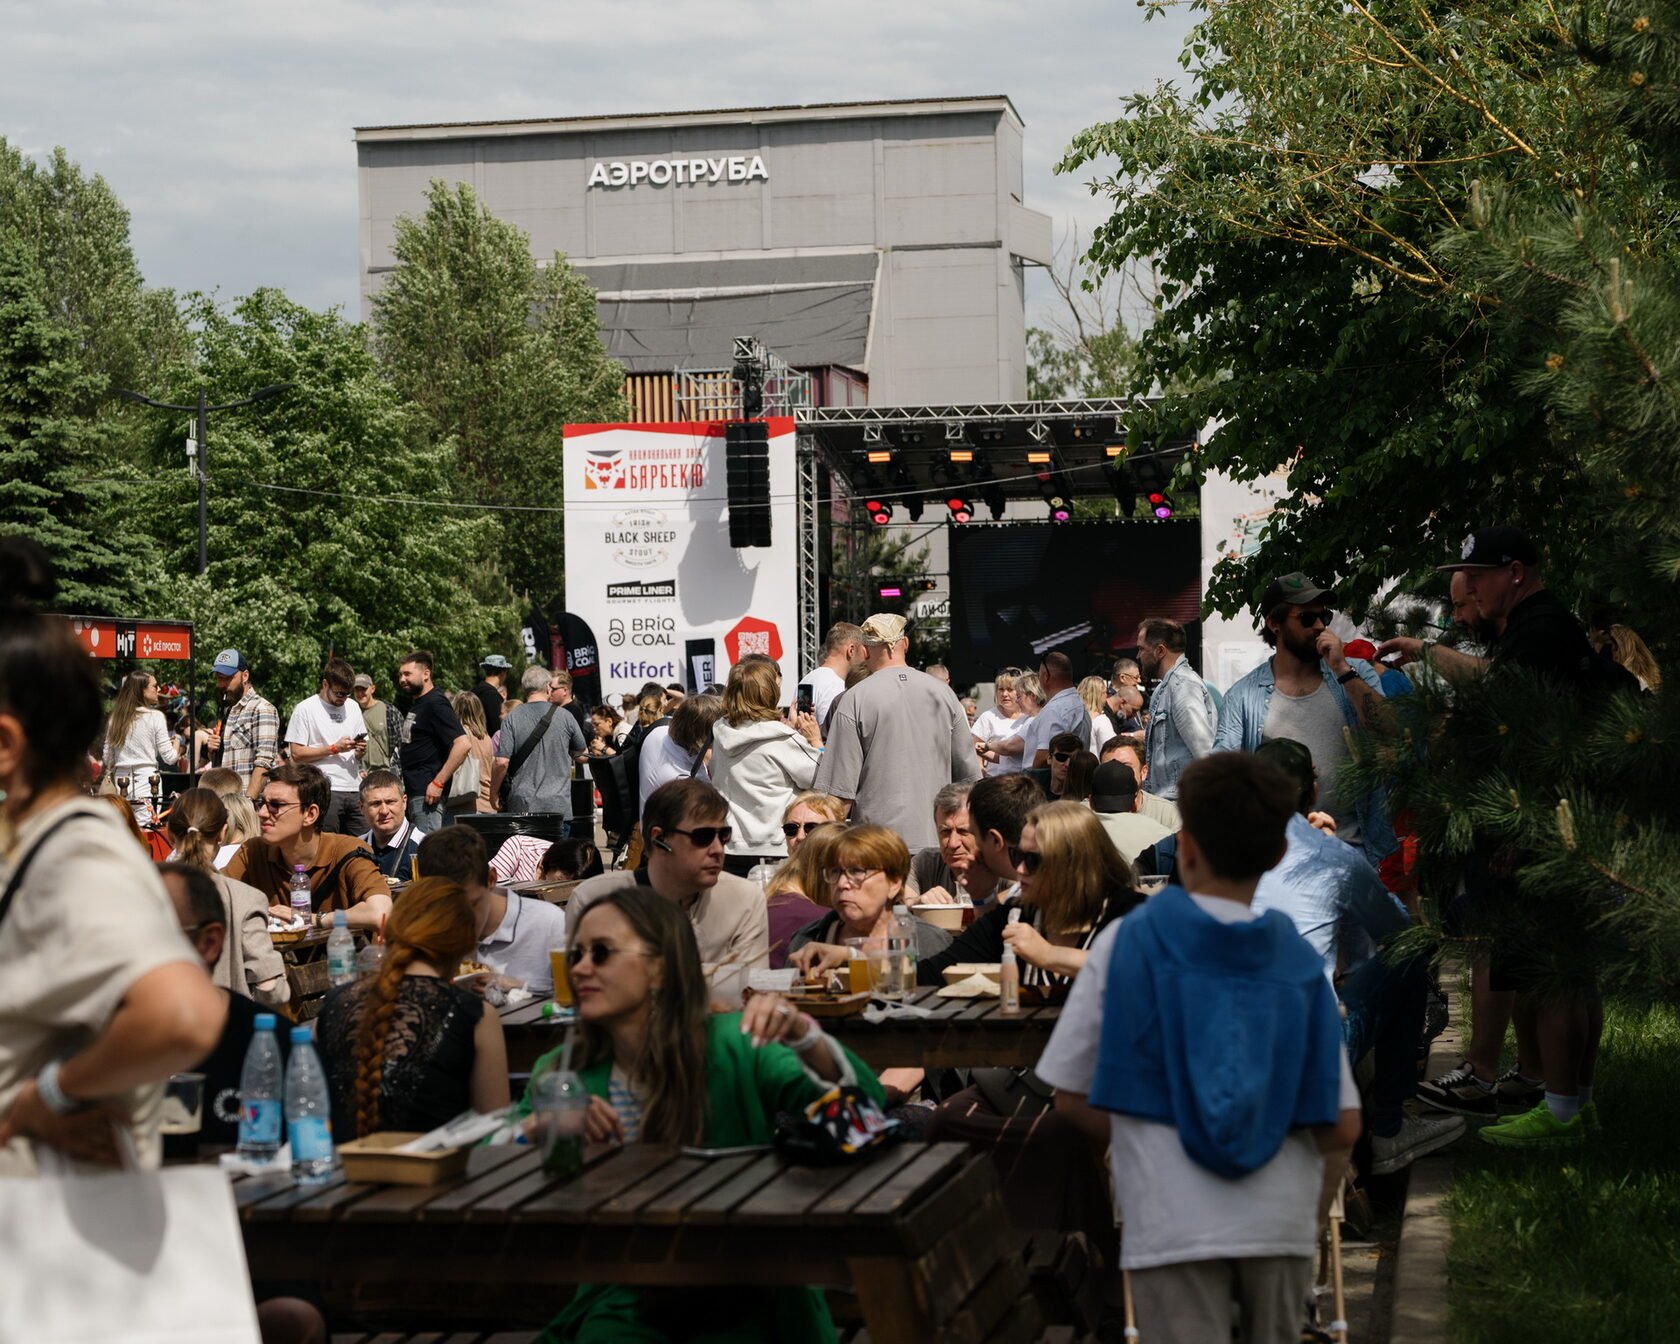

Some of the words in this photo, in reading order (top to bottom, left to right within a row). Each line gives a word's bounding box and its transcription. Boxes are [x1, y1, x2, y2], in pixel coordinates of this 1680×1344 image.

[587, 155, 769, 187] АЭРОТРУБА
[629, 463, 703, 491] БАРБЕКЮ
[604, 531, 639, 544] BLACK
[643, 531, 677, 543] SHEEP
[609, 586, 641, 596] PRIME
[642, 585, 673, 595] LINER
[631, 633, 676, 646] COAL
[610, 660, 675, 679] Kitfort
